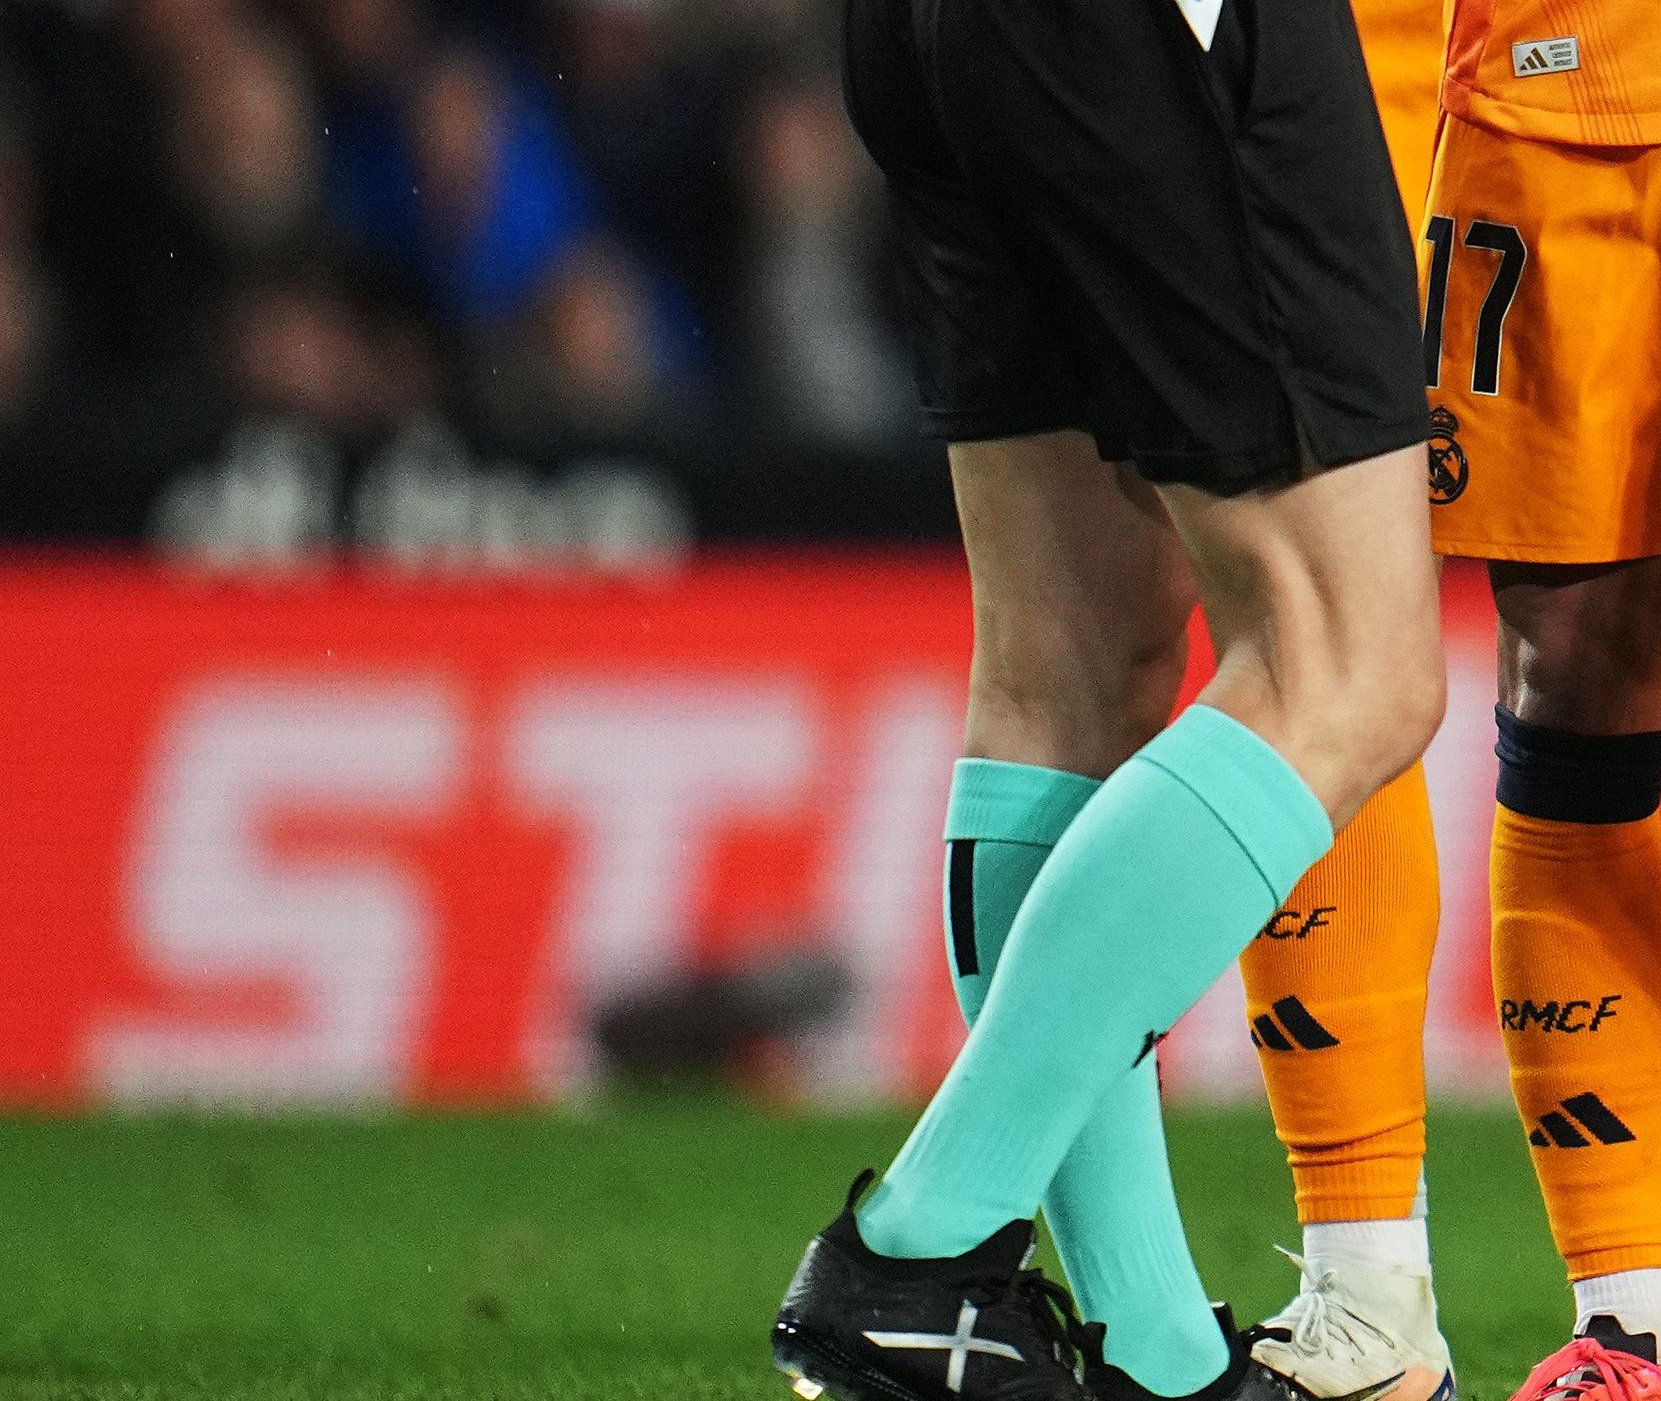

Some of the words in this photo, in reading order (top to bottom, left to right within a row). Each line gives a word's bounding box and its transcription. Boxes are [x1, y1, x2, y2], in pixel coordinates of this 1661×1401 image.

[1422, 214, 1528, 396] 17
[1255, 906, 1337, 939] CF
[1501, 995, 1622, 1033] RMCF
